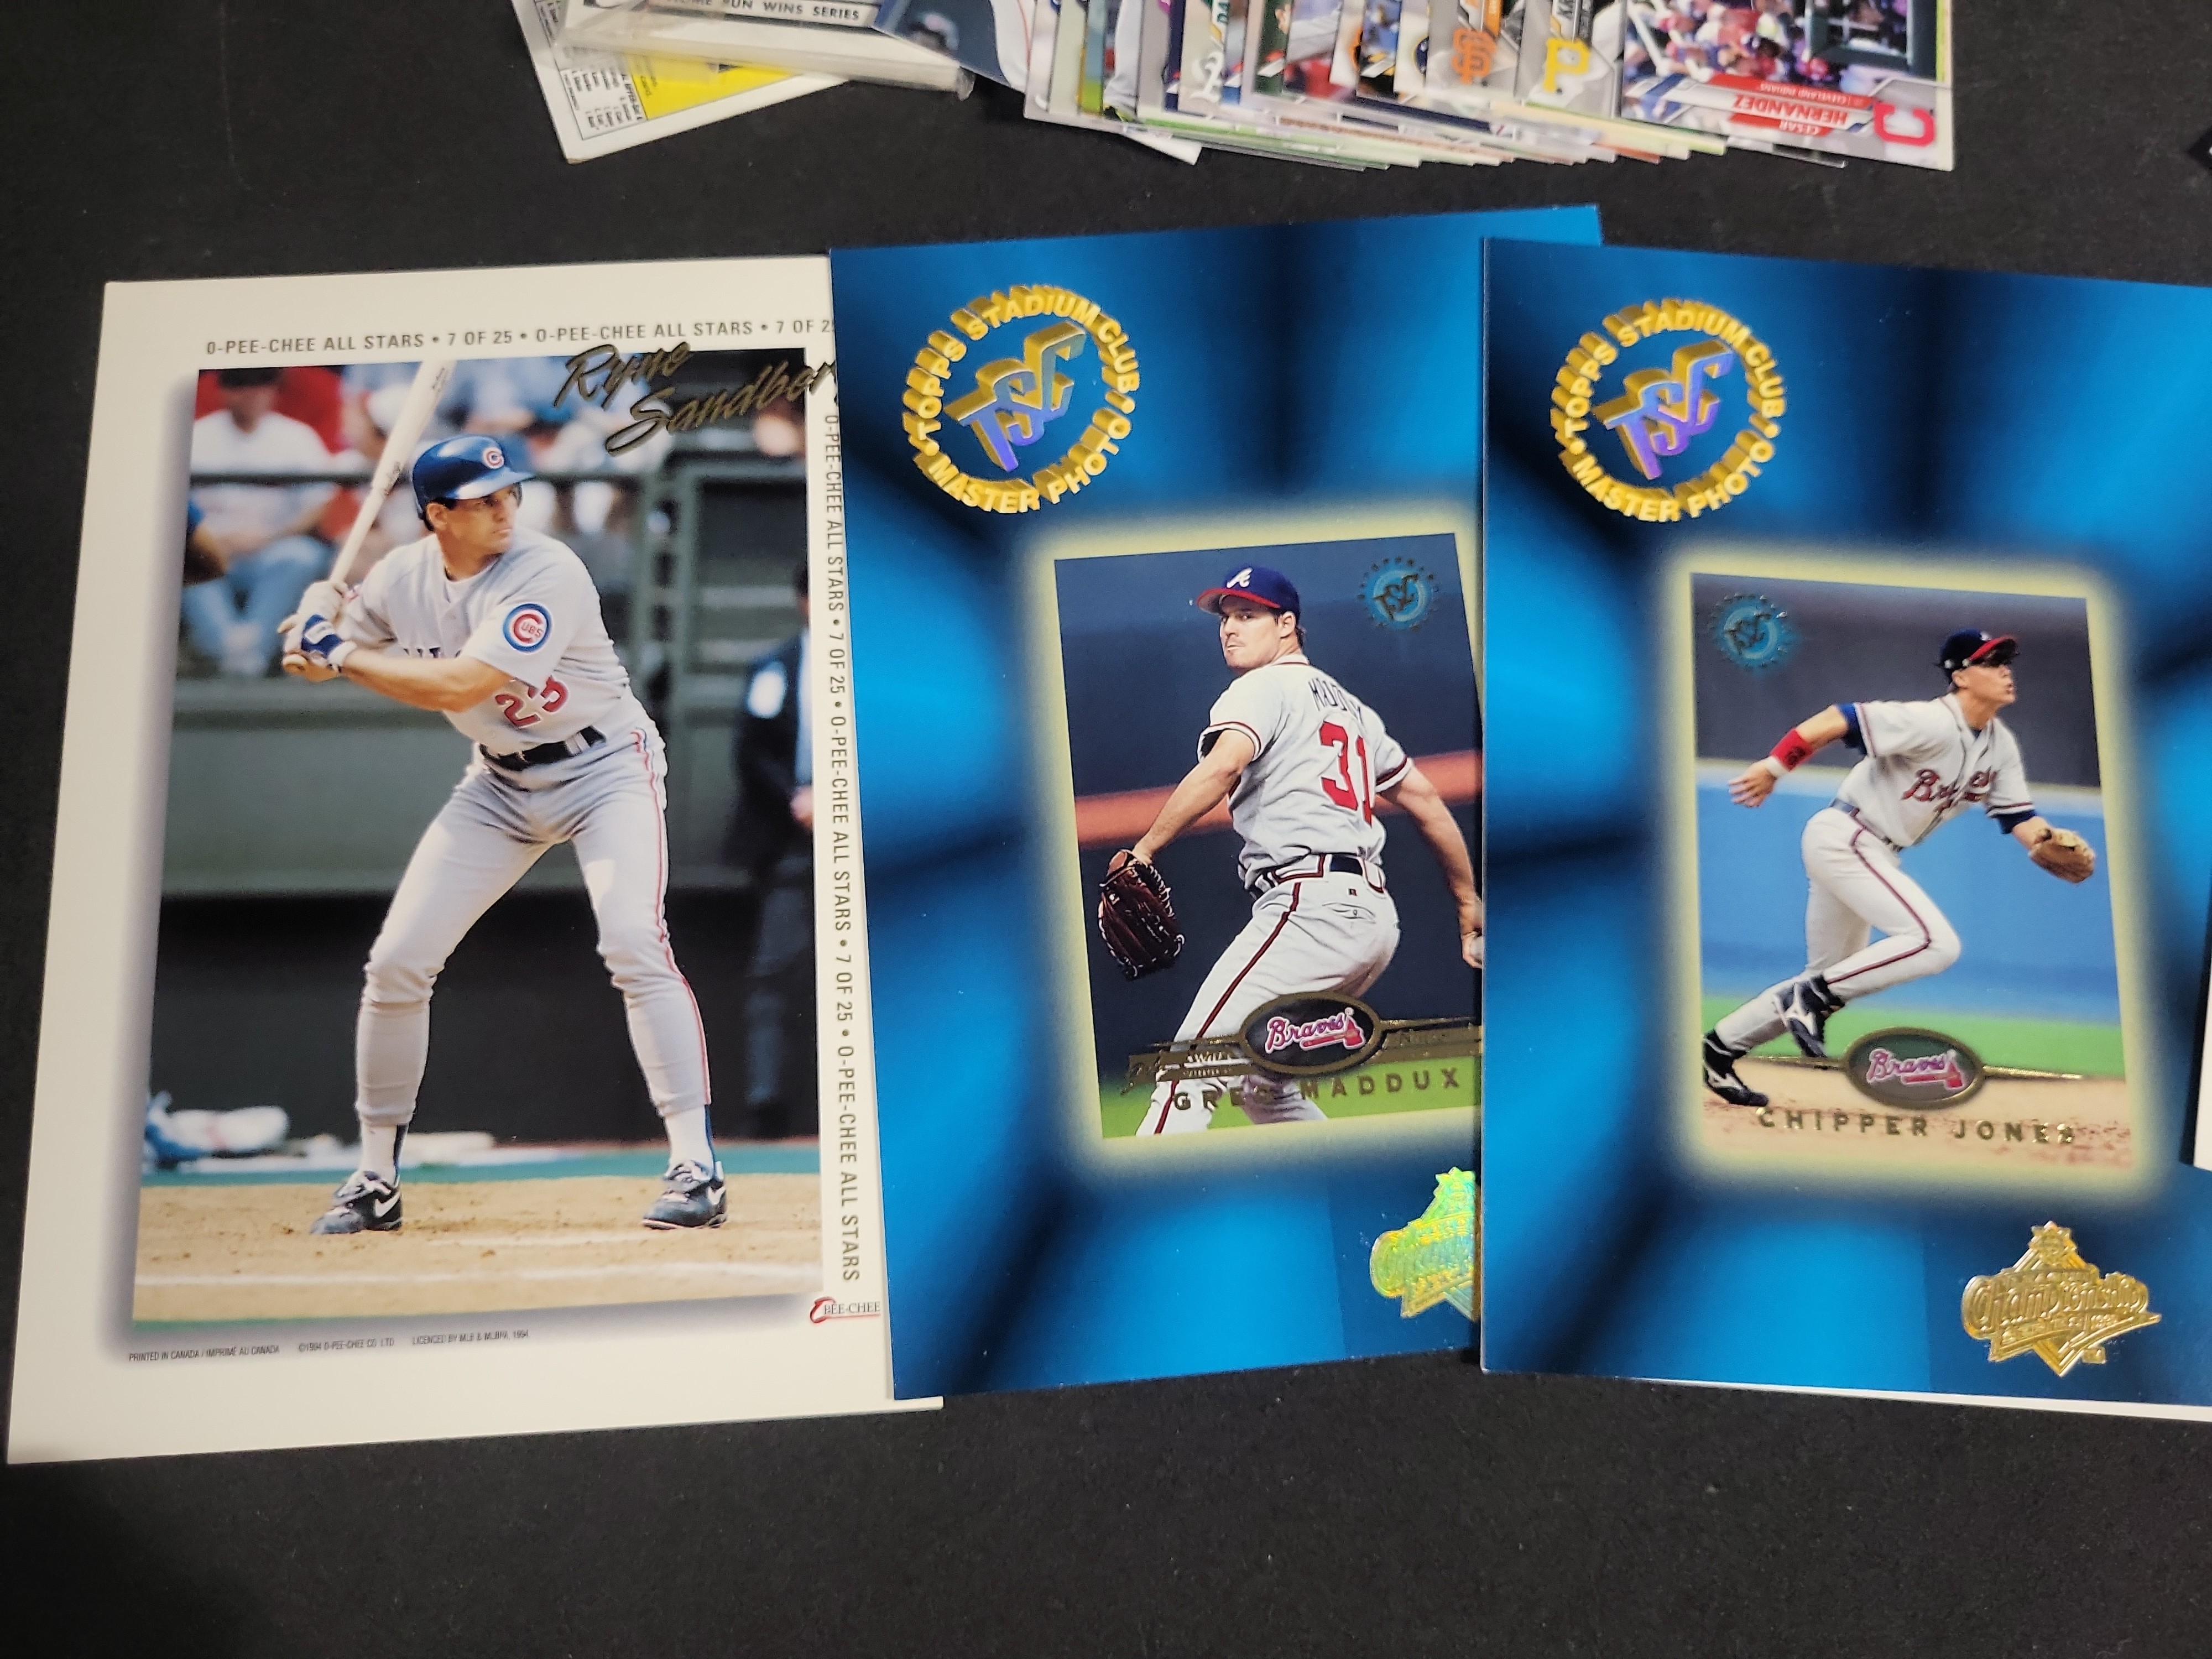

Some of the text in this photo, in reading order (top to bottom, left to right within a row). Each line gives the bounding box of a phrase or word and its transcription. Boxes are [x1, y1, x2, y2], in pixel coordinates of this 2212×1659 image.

[764, 1, 804, 15] WINS
[812, 6, 860, 20] SERIES
[1733, 94, 1849, 125] HERNANDEZ
[324, 336, 356, 351] ALL
[364, 333, 424, 349] STARS
[447, 333, 456, 347] 7
[464, 331, 487, 346] OF
[493, 330, 513, 345] 25
[654, 323, 684, 338] ALL
[693, 321, 753, 336] STARS
[776, 321, 784, 333] 7
[792, 320, 814, 333] OF
[950, 284, 1140, 394] STADIUM CLUB
[1602, 297, 1787, 419] STADIUM CLUB
[902, 329, 967, 441] TOPPS
[1550, 331, 1619, 439] TOPPS
[606, 359, 836, 457] Sandber
[914, 407, 1131, 514] MASTER PHOTO
[1558, 429, 1776, 523] MASTER PHOTO
[827, 520, 843, 549] ALL
[827, 556, 844, 611] STARS
[830, 633, 844, 642] 7
[830, 649, 846, 669] OF
[830, 676, 846, 694] 25
[1318, 720, 1375, 827] 31
[833, 831, 850, 864] ALL
[834, 871, 851, 931] STARS
[836, 954, 852, 963] 7
[836, 973, 853, 994] OF
[836, 1001, 854, 1022] 25
[1264, 1010, 1347, 1055] Braves
[1866, 1047, 1947, 1084] Braves
[1300, 1067, 1460, 1101] MADDUX
[1756, 1105, 2076, 1146] CHIPPER JONES
[841, 1171, 858, 1207] ALL
[842, 1215, 860, 1281] STARS
[129, 1352, 159, 1361] PRINTED
[161, 1352, 169, 1360] IN
[170, 1349, 200, 1359] CANADA
